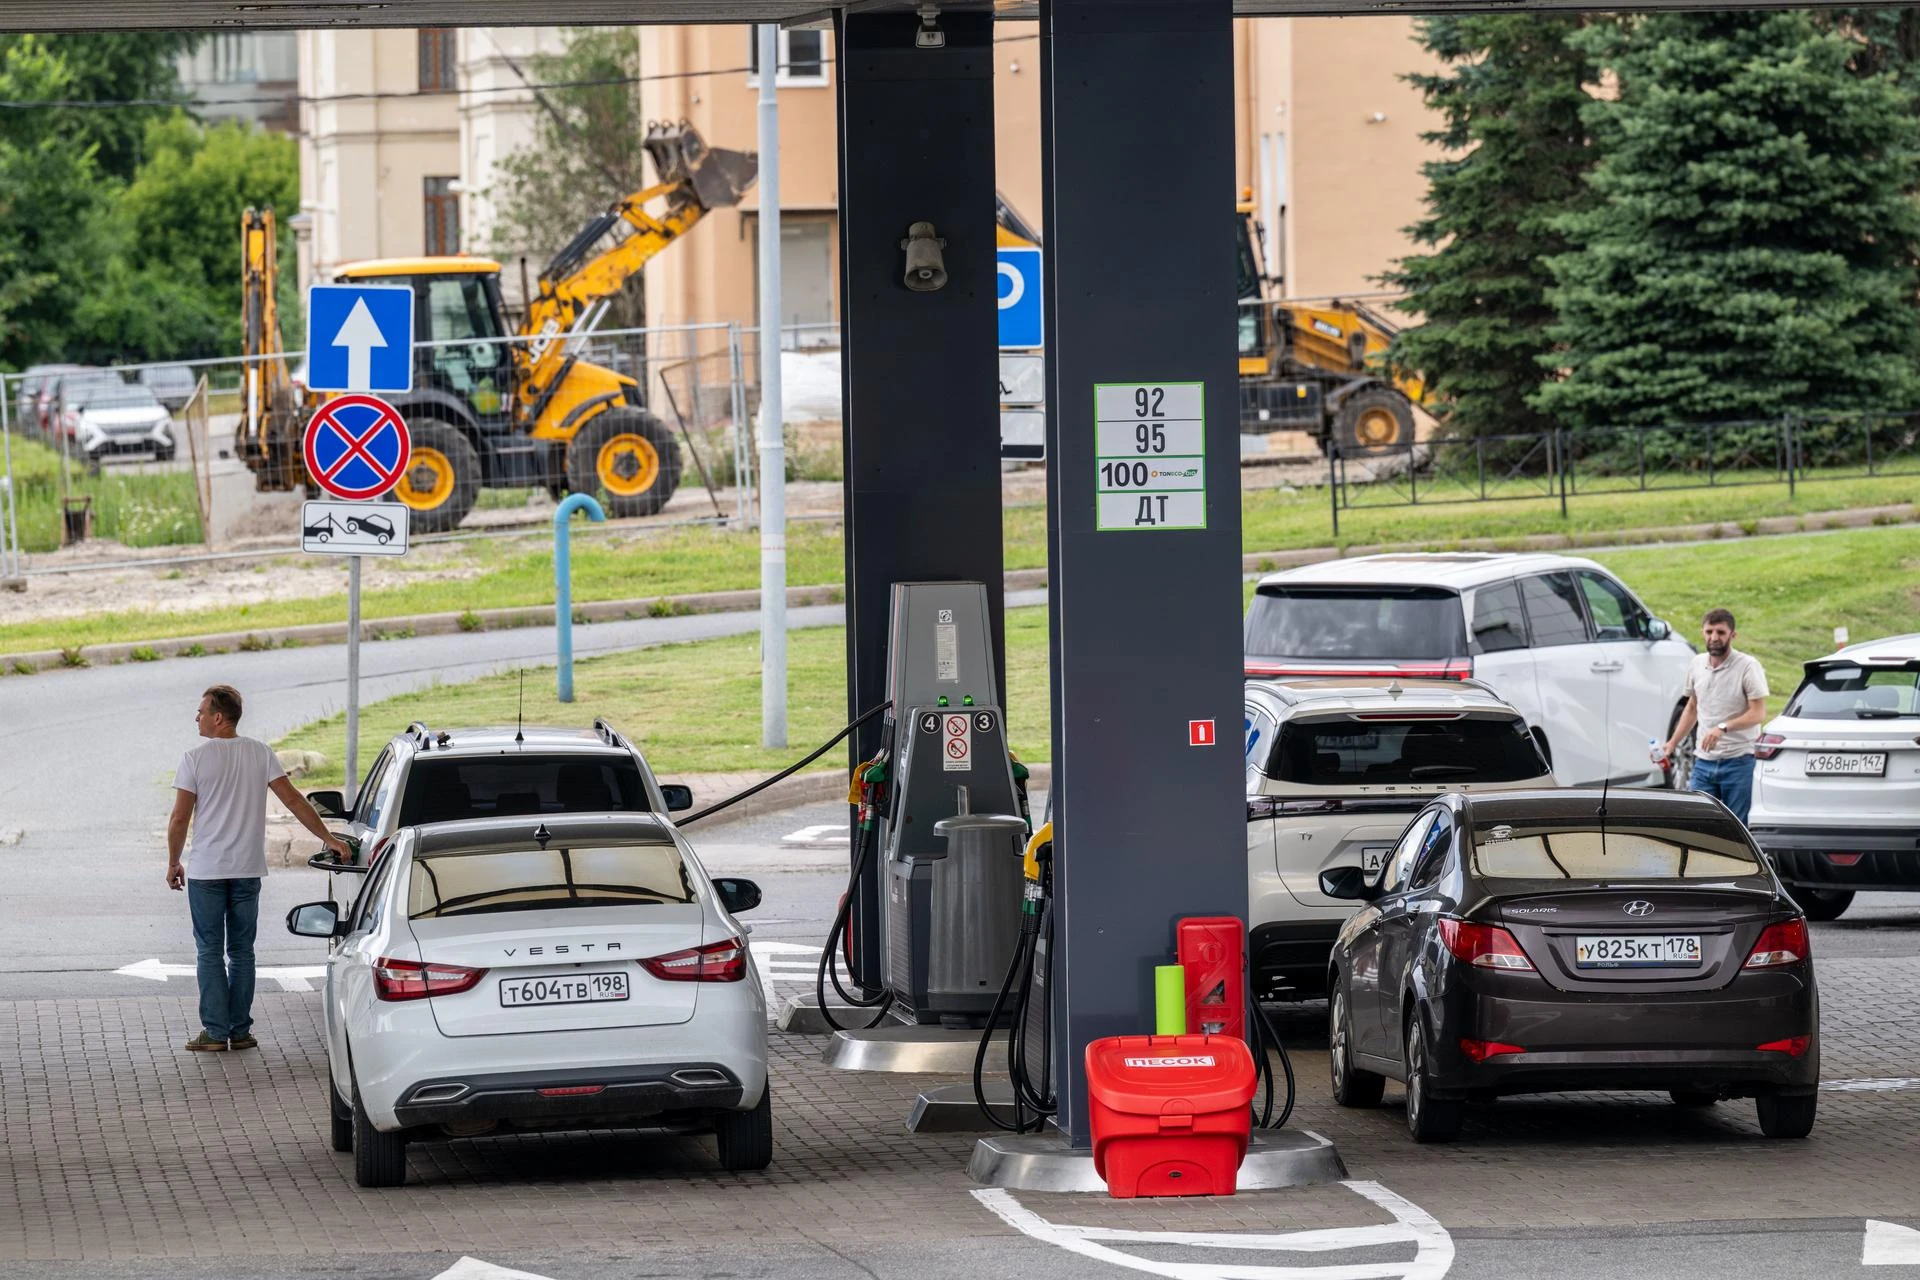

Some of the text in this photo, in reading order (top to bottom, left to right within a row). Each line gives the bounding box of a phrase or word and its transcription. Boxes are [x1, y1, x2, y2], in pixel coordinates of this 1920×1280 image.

[1135, 387, 1165, 417] 92
[1135, 423, 1166, 453] 95
[1101, 462, 1148, 487] 100
[1135, 496, 1169, 525] ДТ
[925, 716, 935, 730] 4
[979, 714, 990, 729] 3
[1809, 755, 1882, 771] К968НР 147
[1511, 906, 1558, 914] SOLARIS
[504, 942, 621, 957] VESTA
[1584, 938, 1695, 960] У825КТ 178
[508, 975, 622, 1002] Т604ТВ 198
[1132, 1057, 1208, 1066] ПЕСОК
